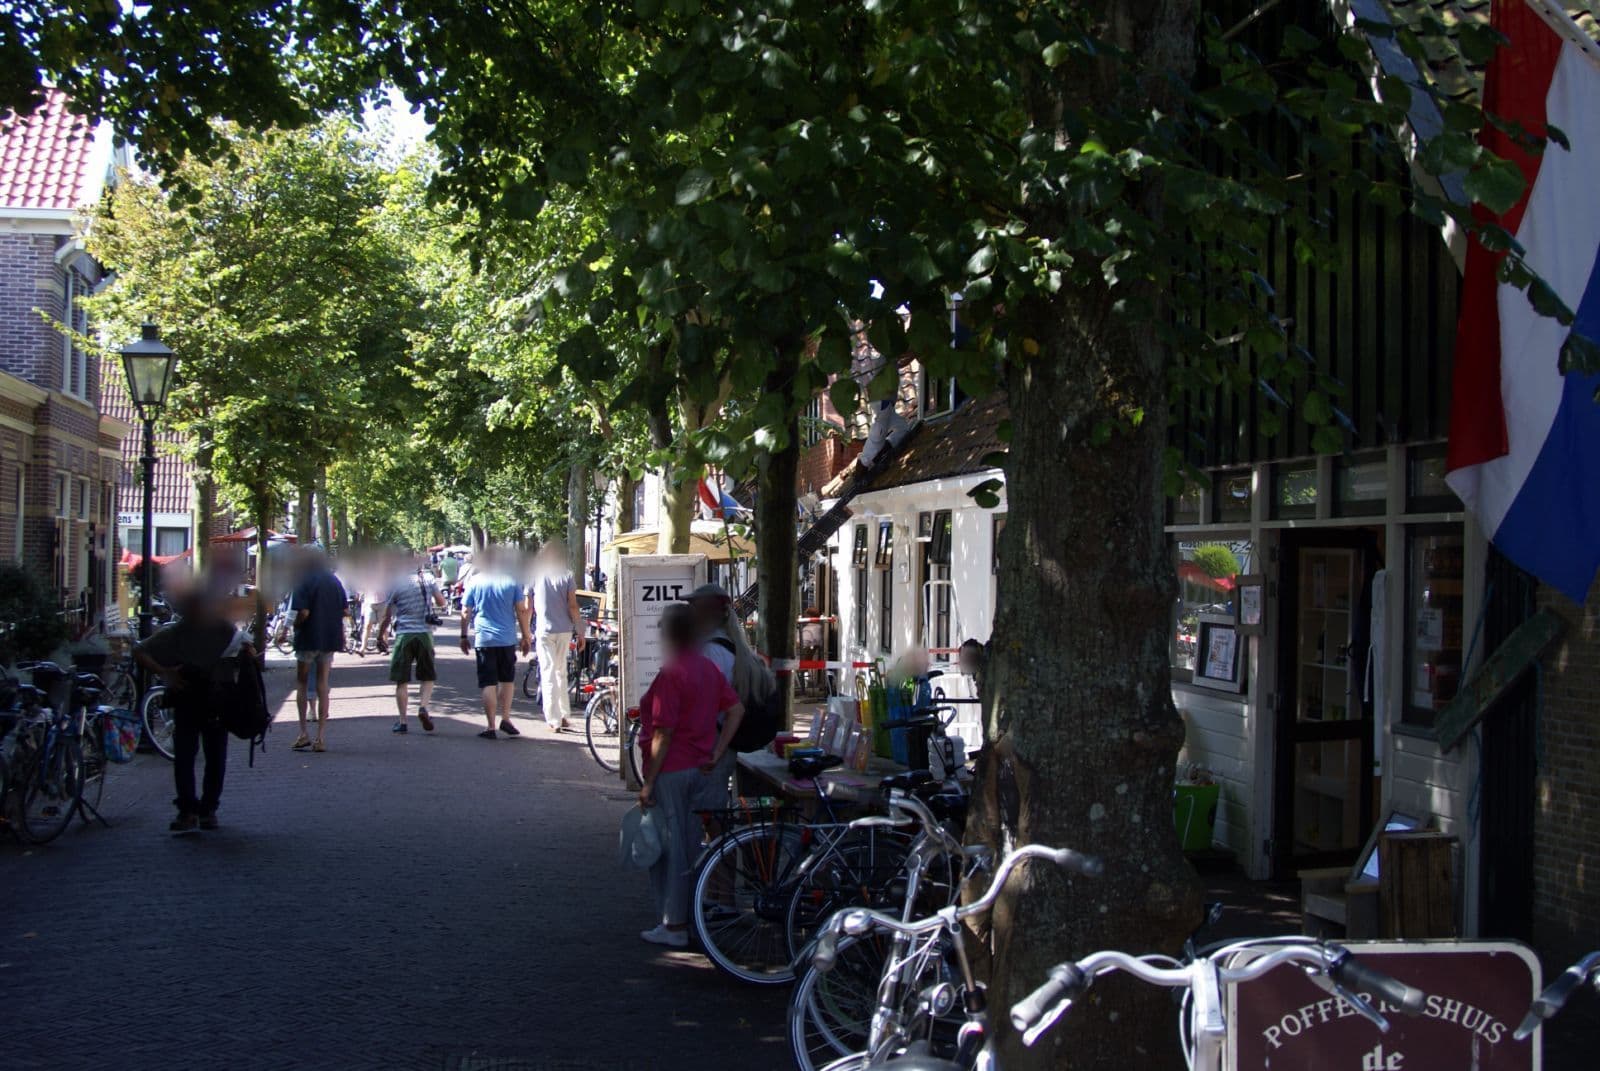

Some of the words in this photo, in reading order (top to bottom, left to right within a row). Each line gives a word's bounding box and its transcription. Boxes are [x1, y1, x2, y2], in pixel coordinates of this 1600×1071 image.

[642, 585, 683, 602] ZILT
[1262, 991, 1509, 1049] POFFESHUIS
[1362, 1044, 1405, 1071] de
